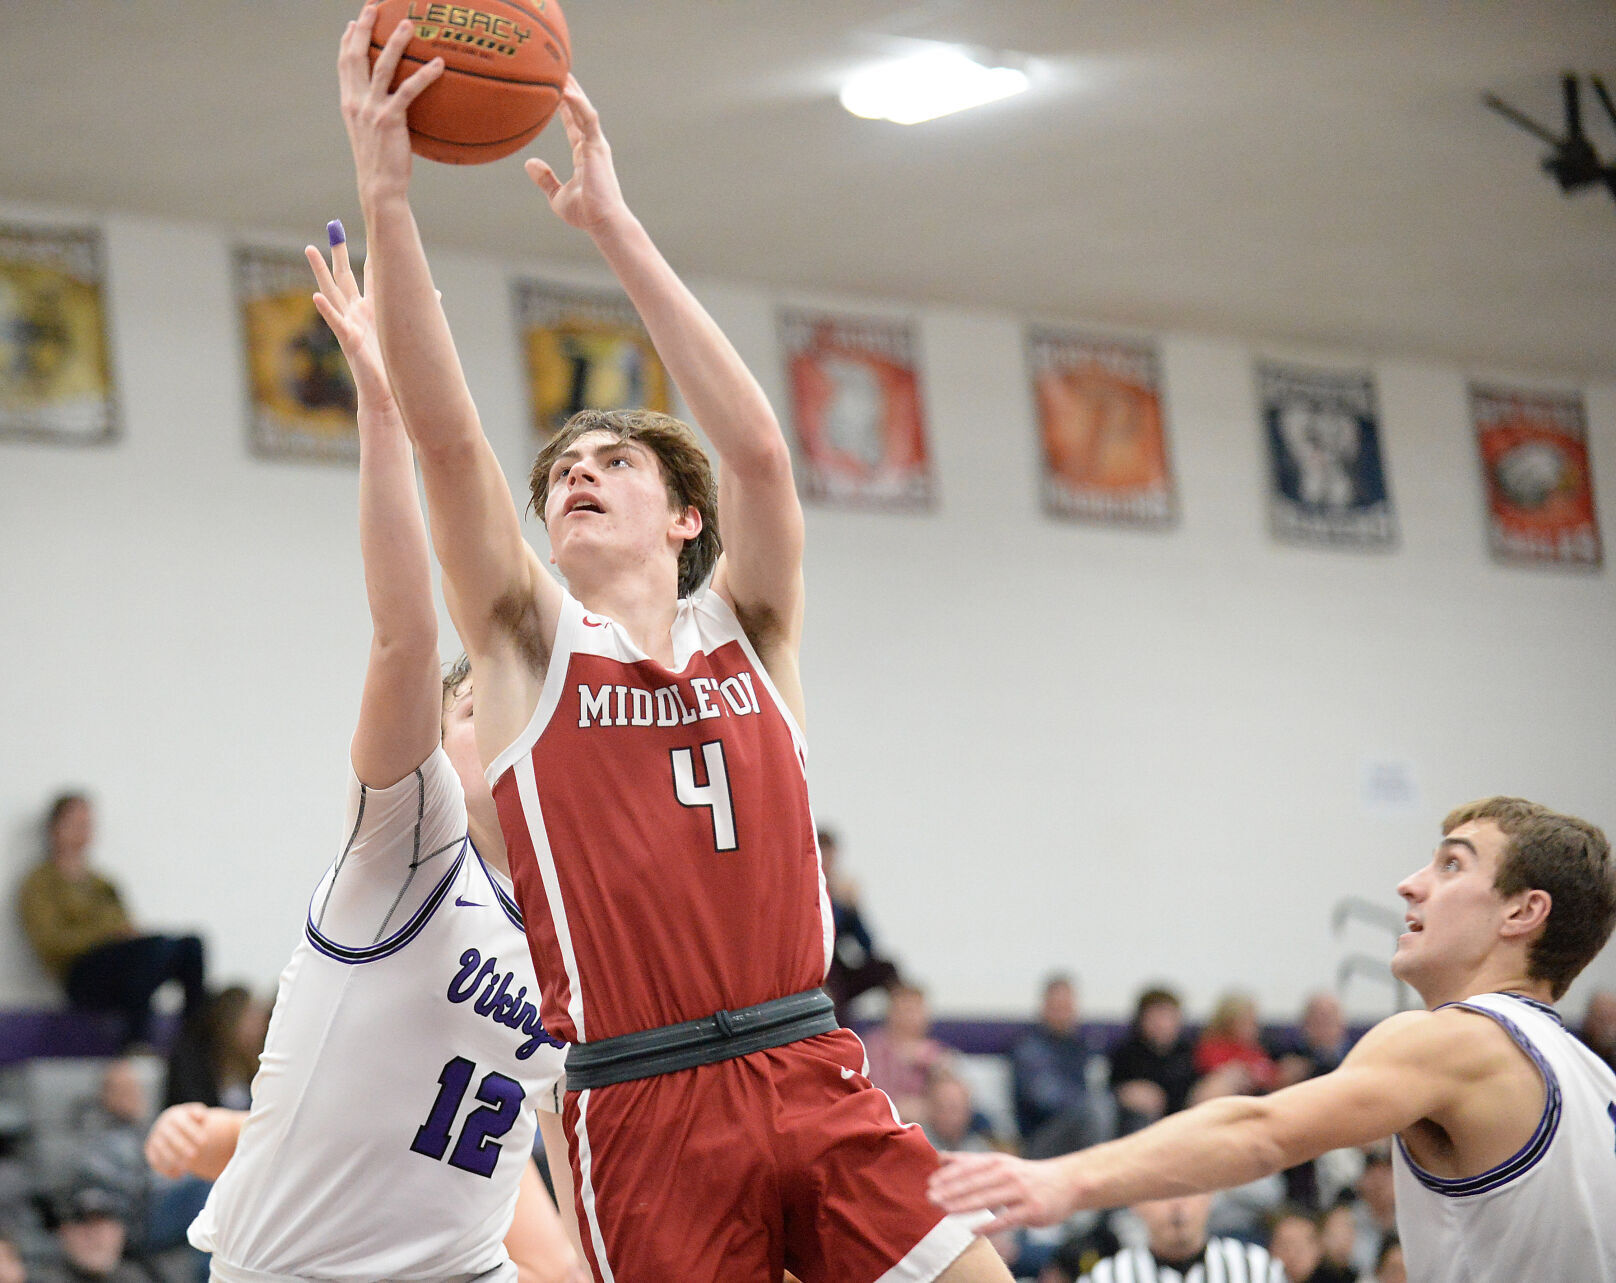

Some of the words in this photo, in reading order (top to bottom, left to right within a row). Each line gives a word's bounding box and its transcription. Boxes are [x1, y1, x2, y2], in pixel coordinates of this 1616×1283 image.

[407, 1, 532, 44] LEGACY
[578, 672, 761, 728] MIDDLEO
[669, 739, 739, 853] 4
[447, 948, 567, 1060] Viking
[409, 1055, 526, 1179] 12
